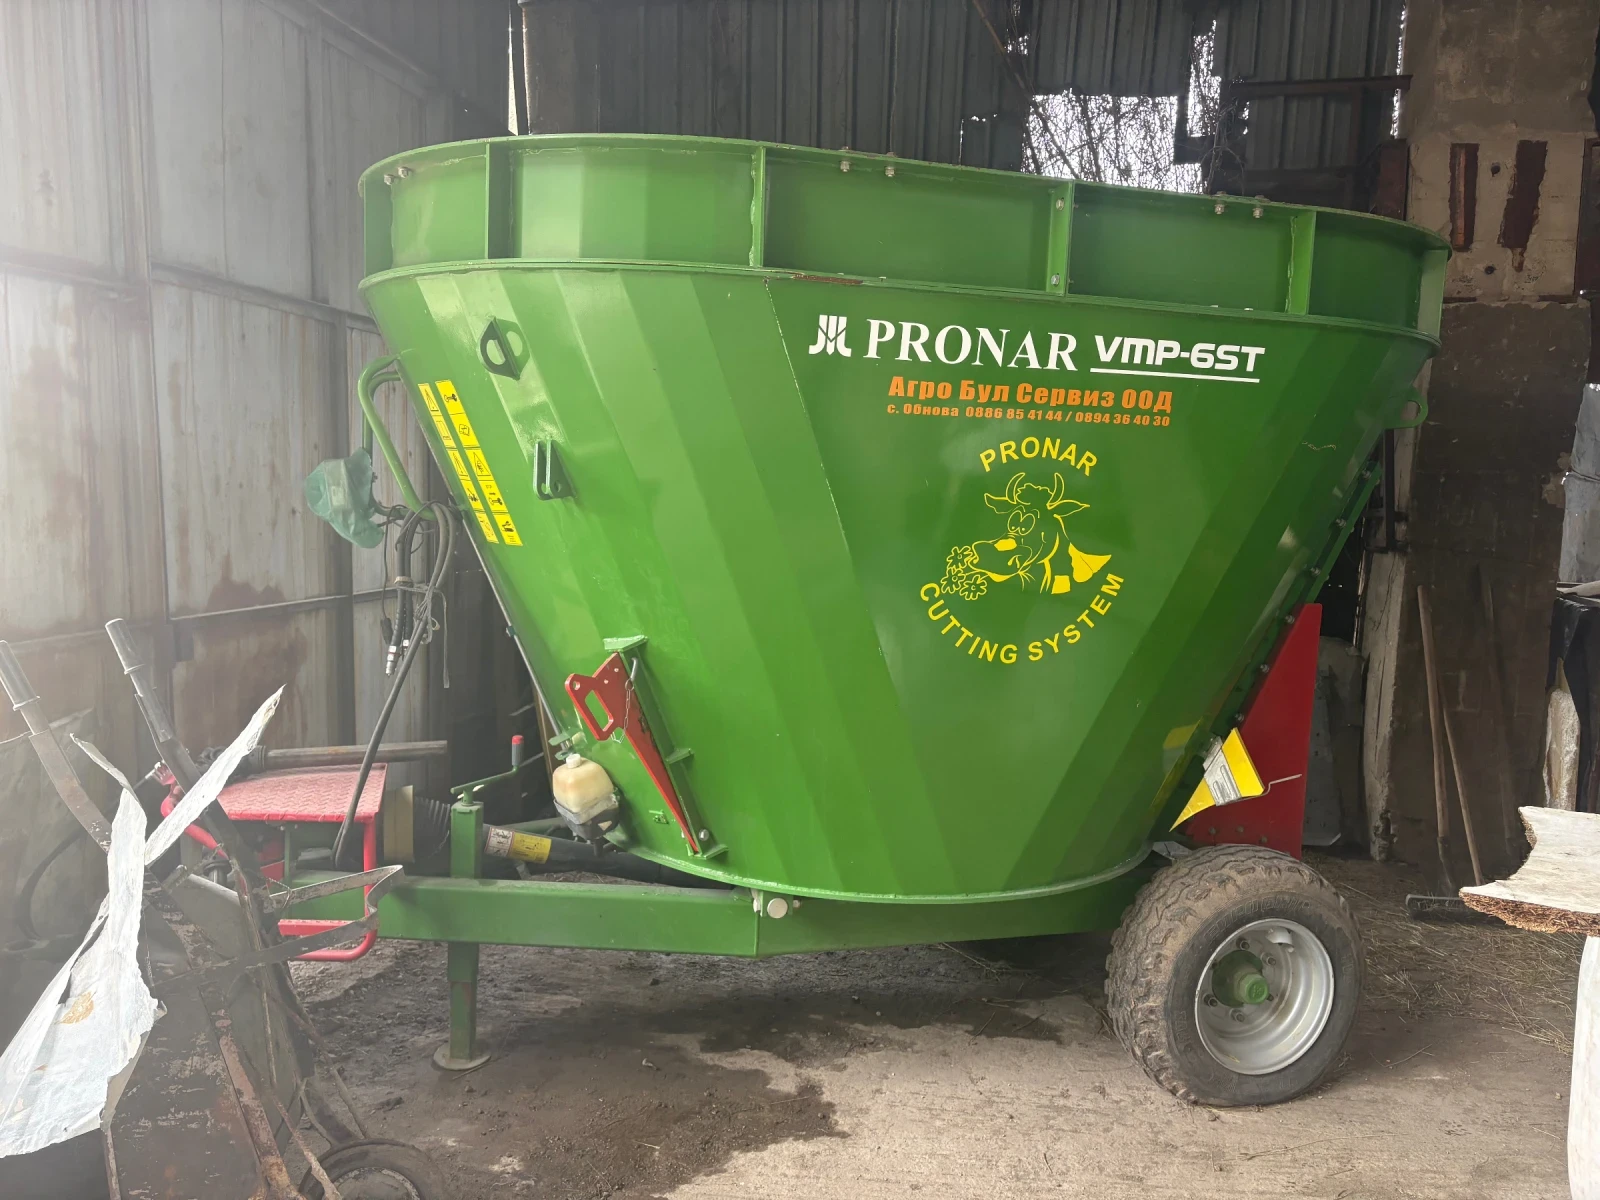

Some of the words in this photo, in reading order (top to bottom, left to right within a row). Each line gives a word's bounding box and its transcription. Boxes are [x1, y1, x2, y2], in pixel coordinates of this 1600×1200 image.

[863, 319, 1077, 371] PRONAR
[1095, 335, 1266, 372] VMP-6ST
[888, 376, 952, 400] Агро
[959, 380, 1009, 403] Бул
[1016, 383, 1115, 407] Сервиз
[1121, 389, 1173, 413] ООД
[887, 404, 899, 414] с.
[903, 403, 959, 417] Обнова
[965, 406, 1003, 419] 0886
[1006, 408, 1024, 420] 85
[1075, 412, 1110, 424] 0894
[1114, 413, 1131, 425] 36
[1133, 415, 1150, 426] 40
[1153, 416, 1170, 427] 30
[979, 437, 1098, 476] PRONAR
[920, 582, 1018, 664] CUTTING
[1028, 573, 1124, 661] SYSTEM
